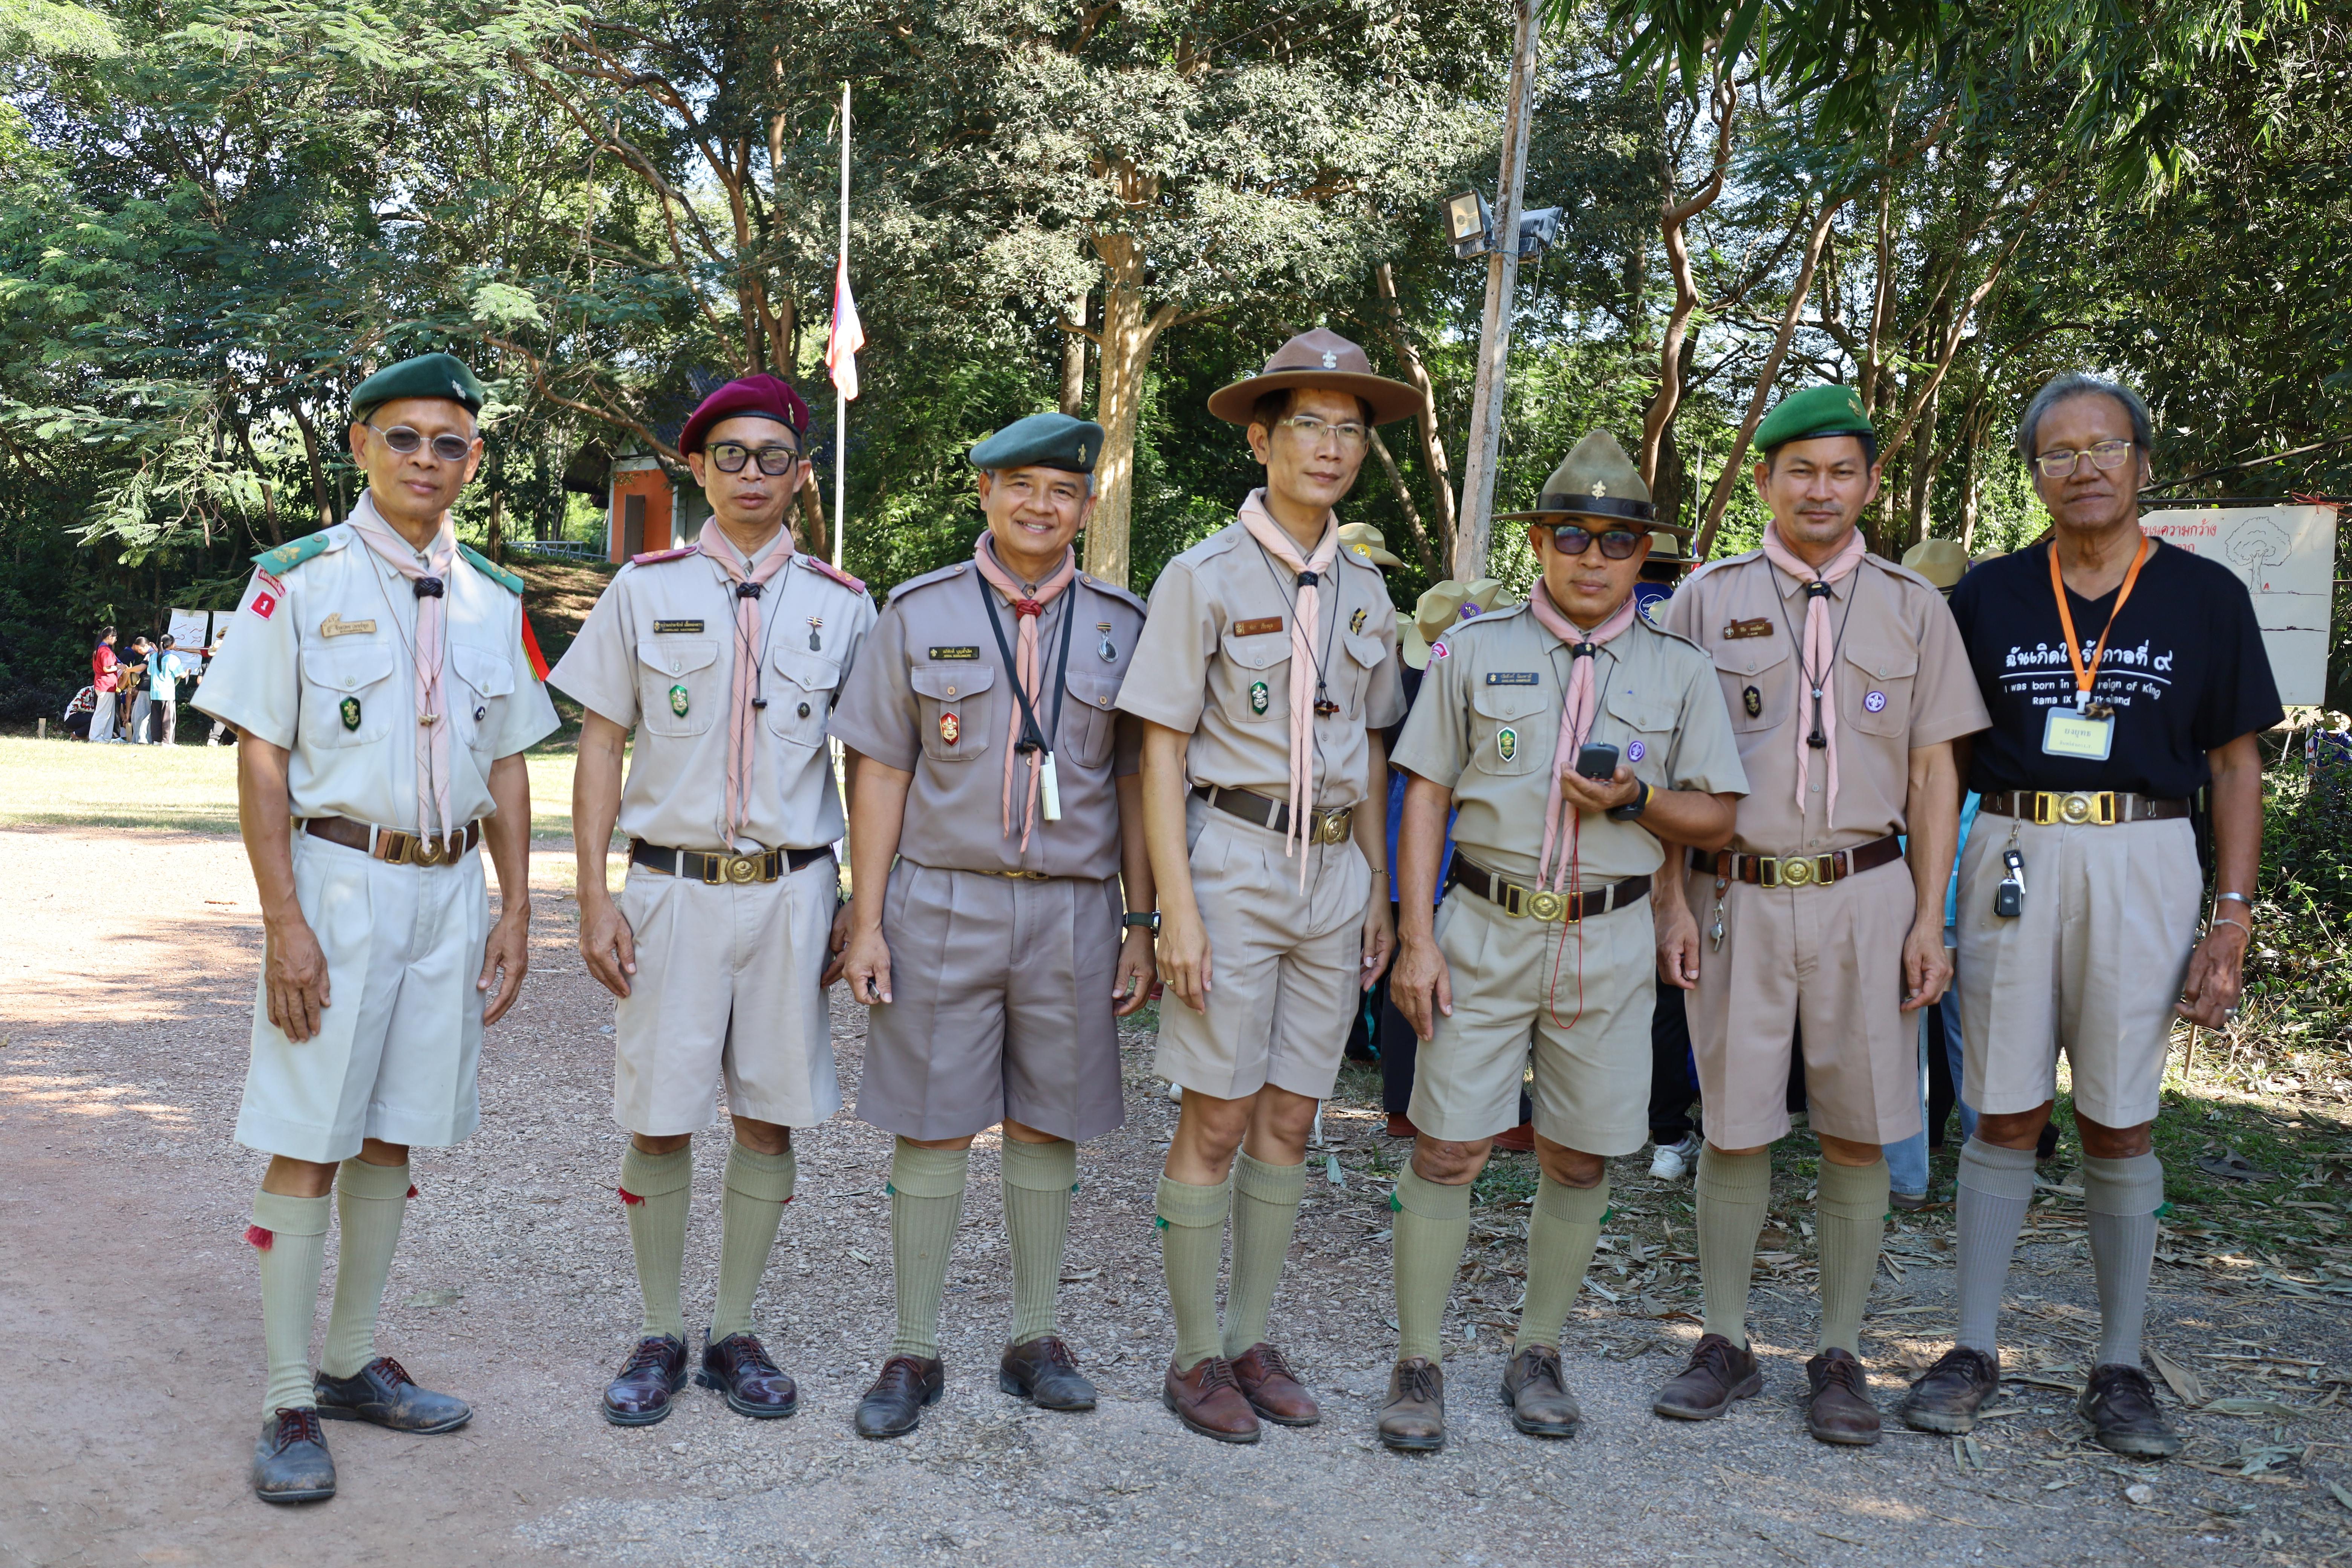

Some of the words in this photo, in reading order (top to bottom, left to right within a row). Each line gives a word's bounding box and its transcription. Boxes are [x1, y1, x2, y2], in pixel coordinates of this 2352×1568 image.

[2263, 582, 2270, 590] A
[260, 600, 269, 611] 1
[2006, 639, 2149, 667] ฉันเกิดใรักาลที่
[2153, 650, 2173, 671] ๙
[2011, 683, 2027, 691] was
[2032, 681, 2055, 690] born
[2060, 678, 2069, 689] in
[2098, 678, 2121, 692] reign
[2126, 681, 2138, 691] of
[2142, 683, 2161, 700] King
[2033, 696, 2058, 705] Rama
[2063, 695, 2072, 704] IX
